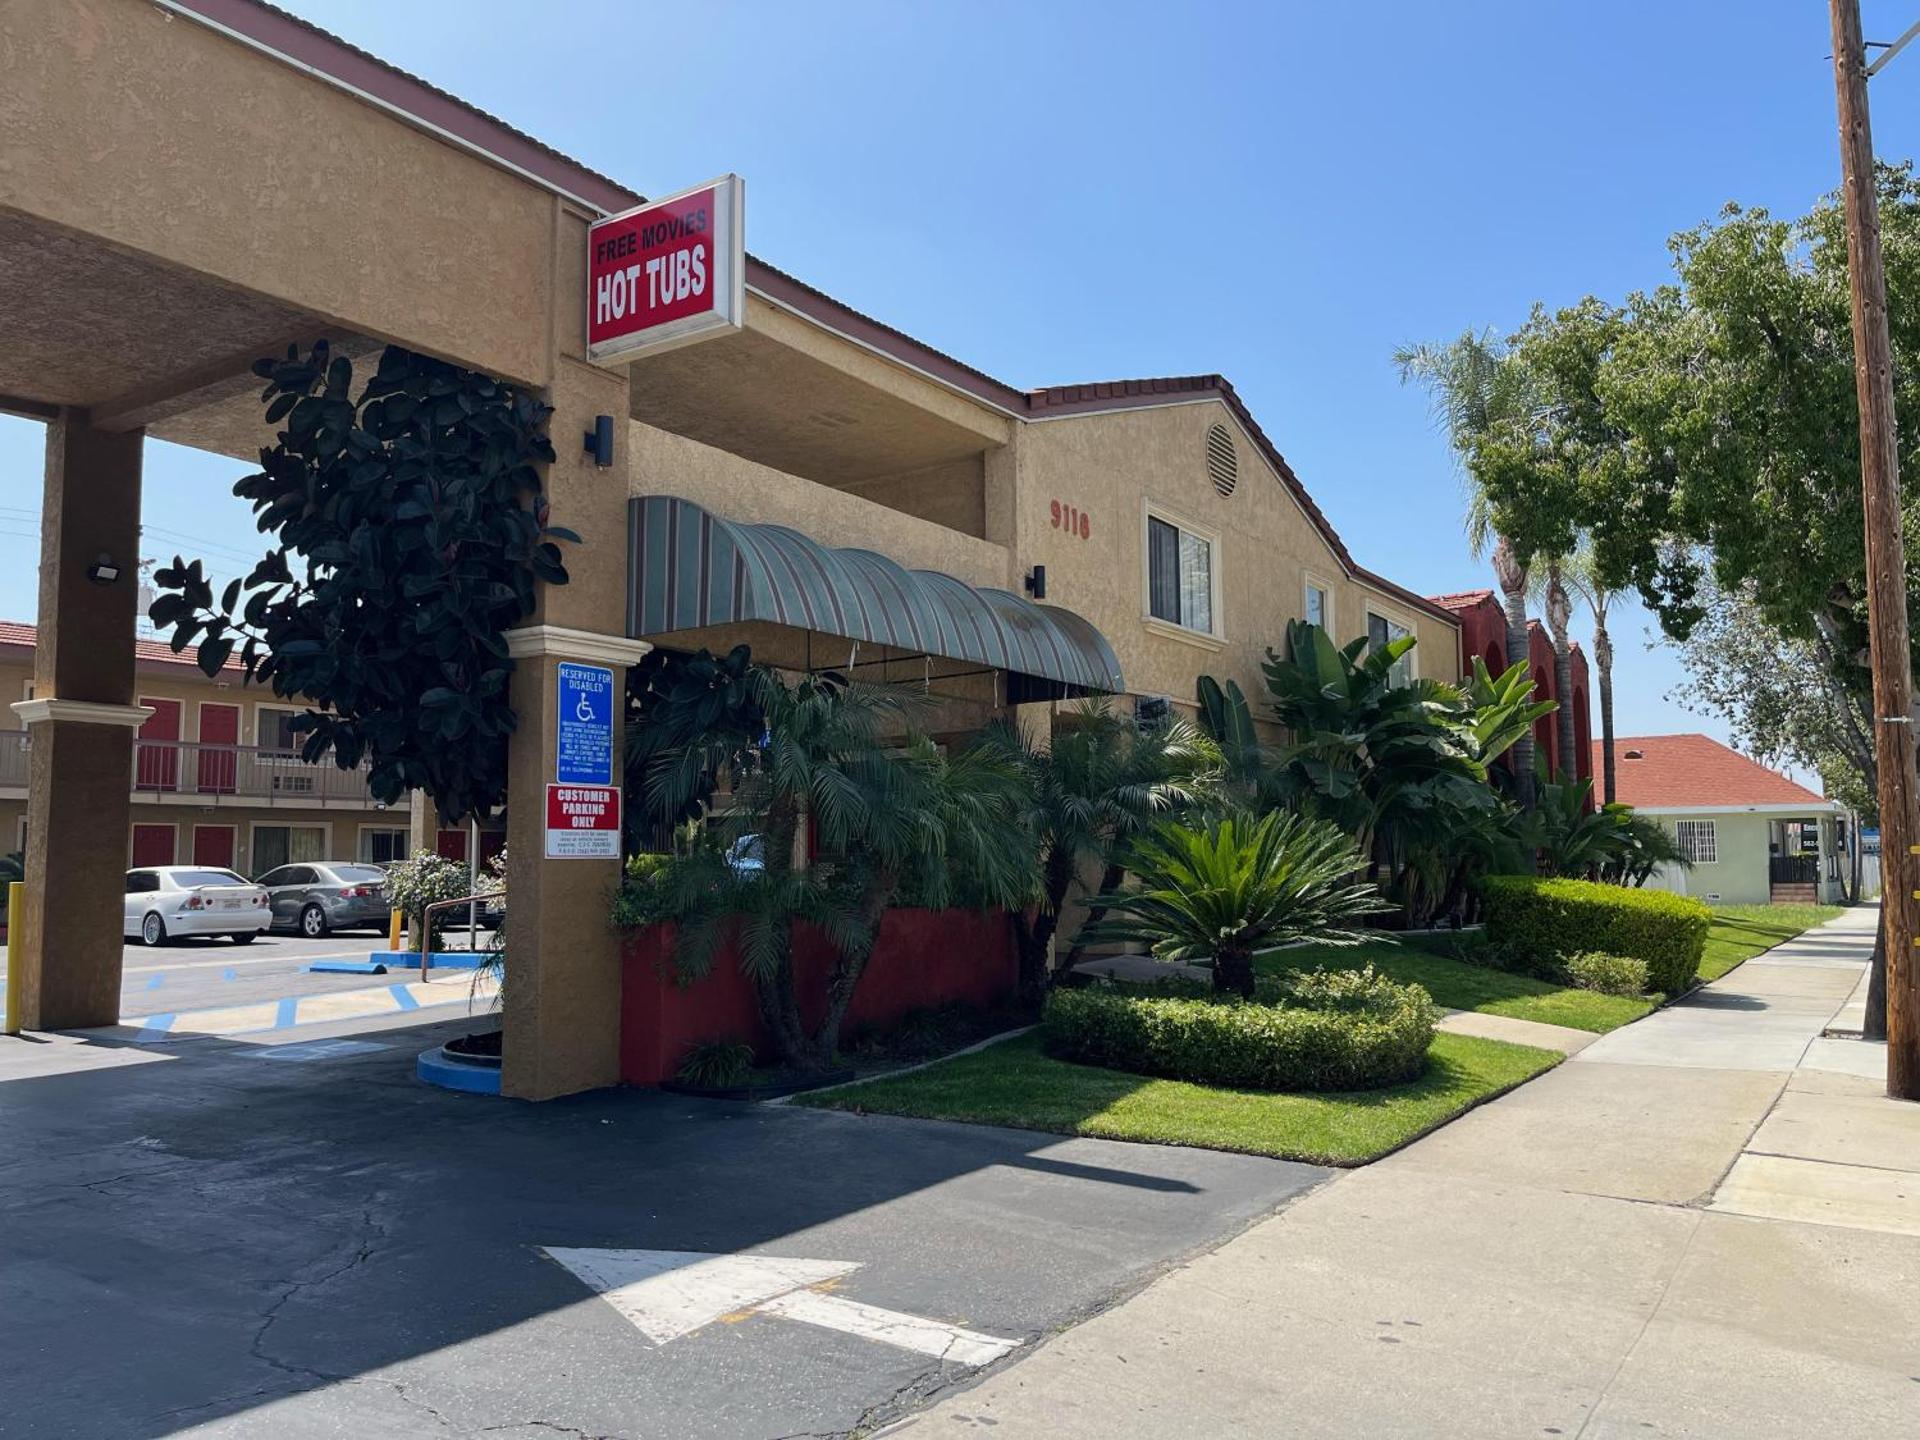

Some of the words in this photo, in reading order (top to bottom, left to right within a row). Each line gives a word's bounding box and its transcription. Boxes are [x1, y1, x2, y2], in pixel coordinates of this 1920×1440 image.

[597, 232, 637, 265] FREE
[642, 208, 706, 250] MOVIES
[597, 264, 641, 325] HOT
[646, 243, 706, 309] TUBS
[562, 668, 596, 681] RESERVED
[598, 673, 611, 684] FOR
[569, 679, 604, 692] DISABLED
[557, 789, 610, 803] CUSTOMER
[562, 802, 605, 815] PARKING
[571, 816, 596, 828] ONLY
